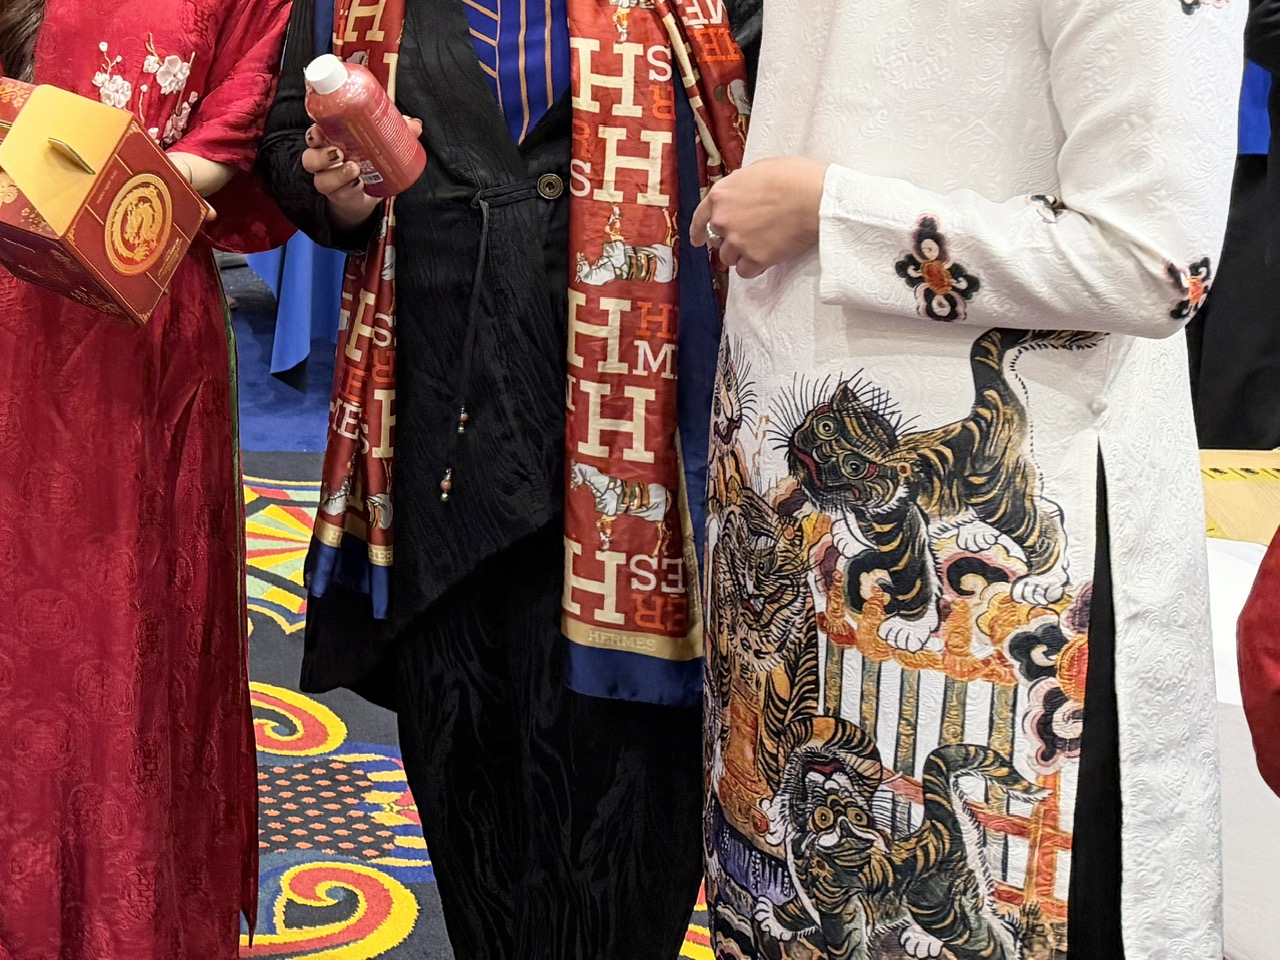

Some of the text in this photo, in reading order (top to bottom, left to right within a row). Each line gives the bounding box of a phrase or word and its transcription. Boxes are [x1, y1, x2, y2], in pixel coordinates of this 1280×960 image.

[570, 37, 644, 118] H
[593, 124, 673, 207] H
[568, 288, 631, 375] H
[577, 379, 656, 463] H
[562, 536, 627, 625] H
